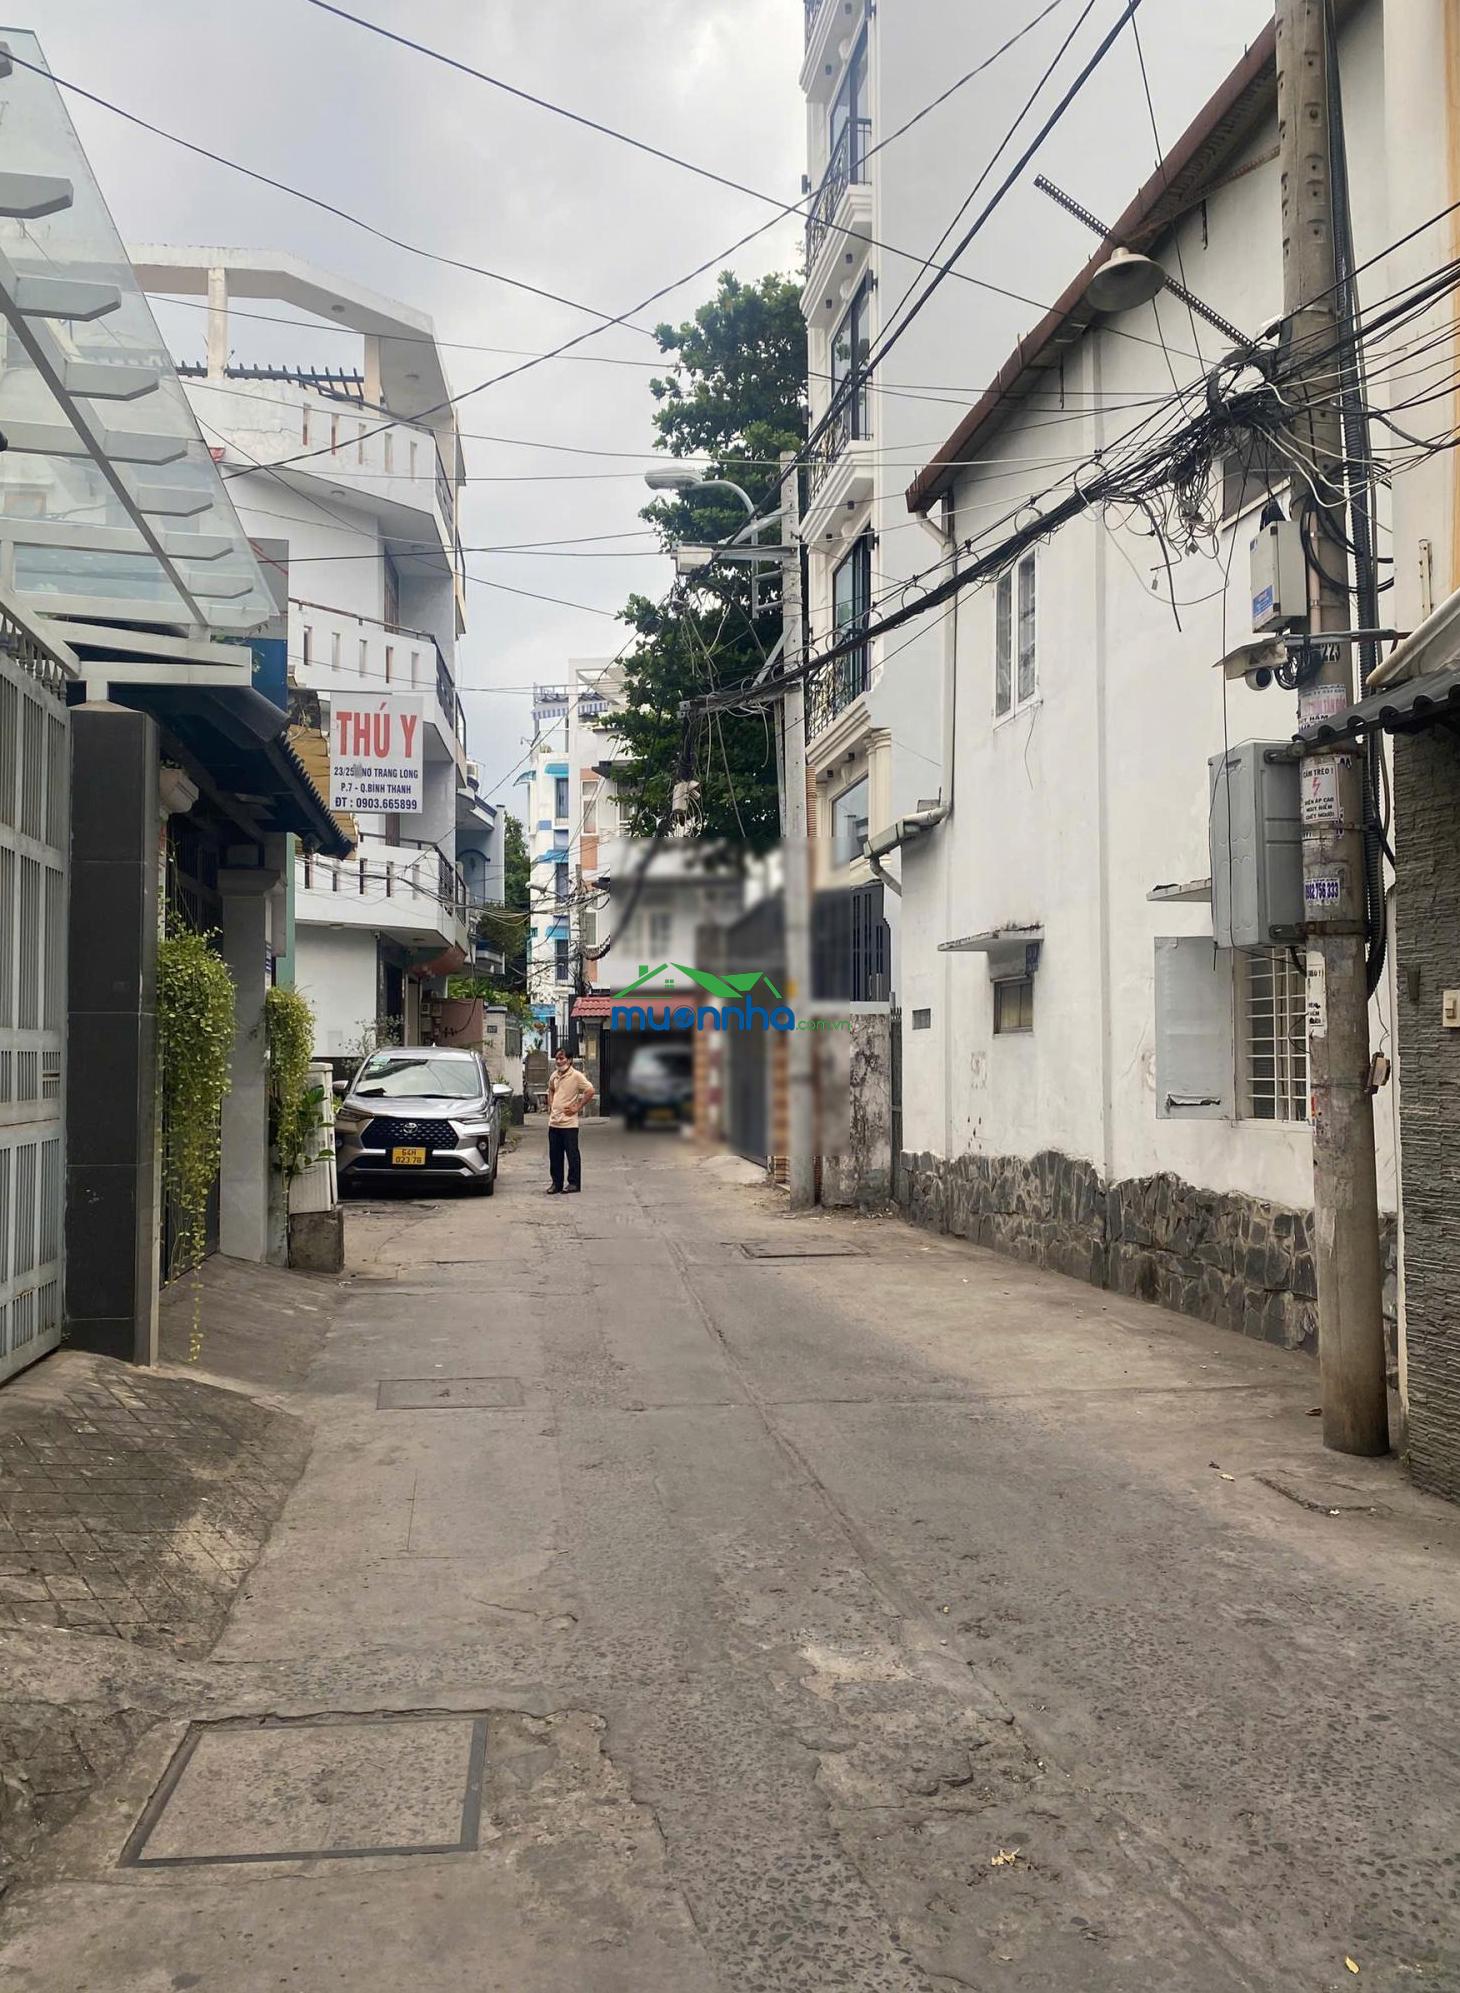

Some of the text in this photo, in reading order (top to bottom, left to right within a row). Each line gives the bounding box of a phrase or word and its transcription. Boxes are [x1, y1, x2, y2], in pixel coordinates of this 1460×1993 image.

[336, 702, 417, 758] THÚ Y
[374, 768, 397, 778] TRANG
[400, 769, 418, 779] LONG
[341, 782, 353, 792] P.7
[335, 797, 348, 807] ĐT
[356, 798, 417, 810] 0903.665899
